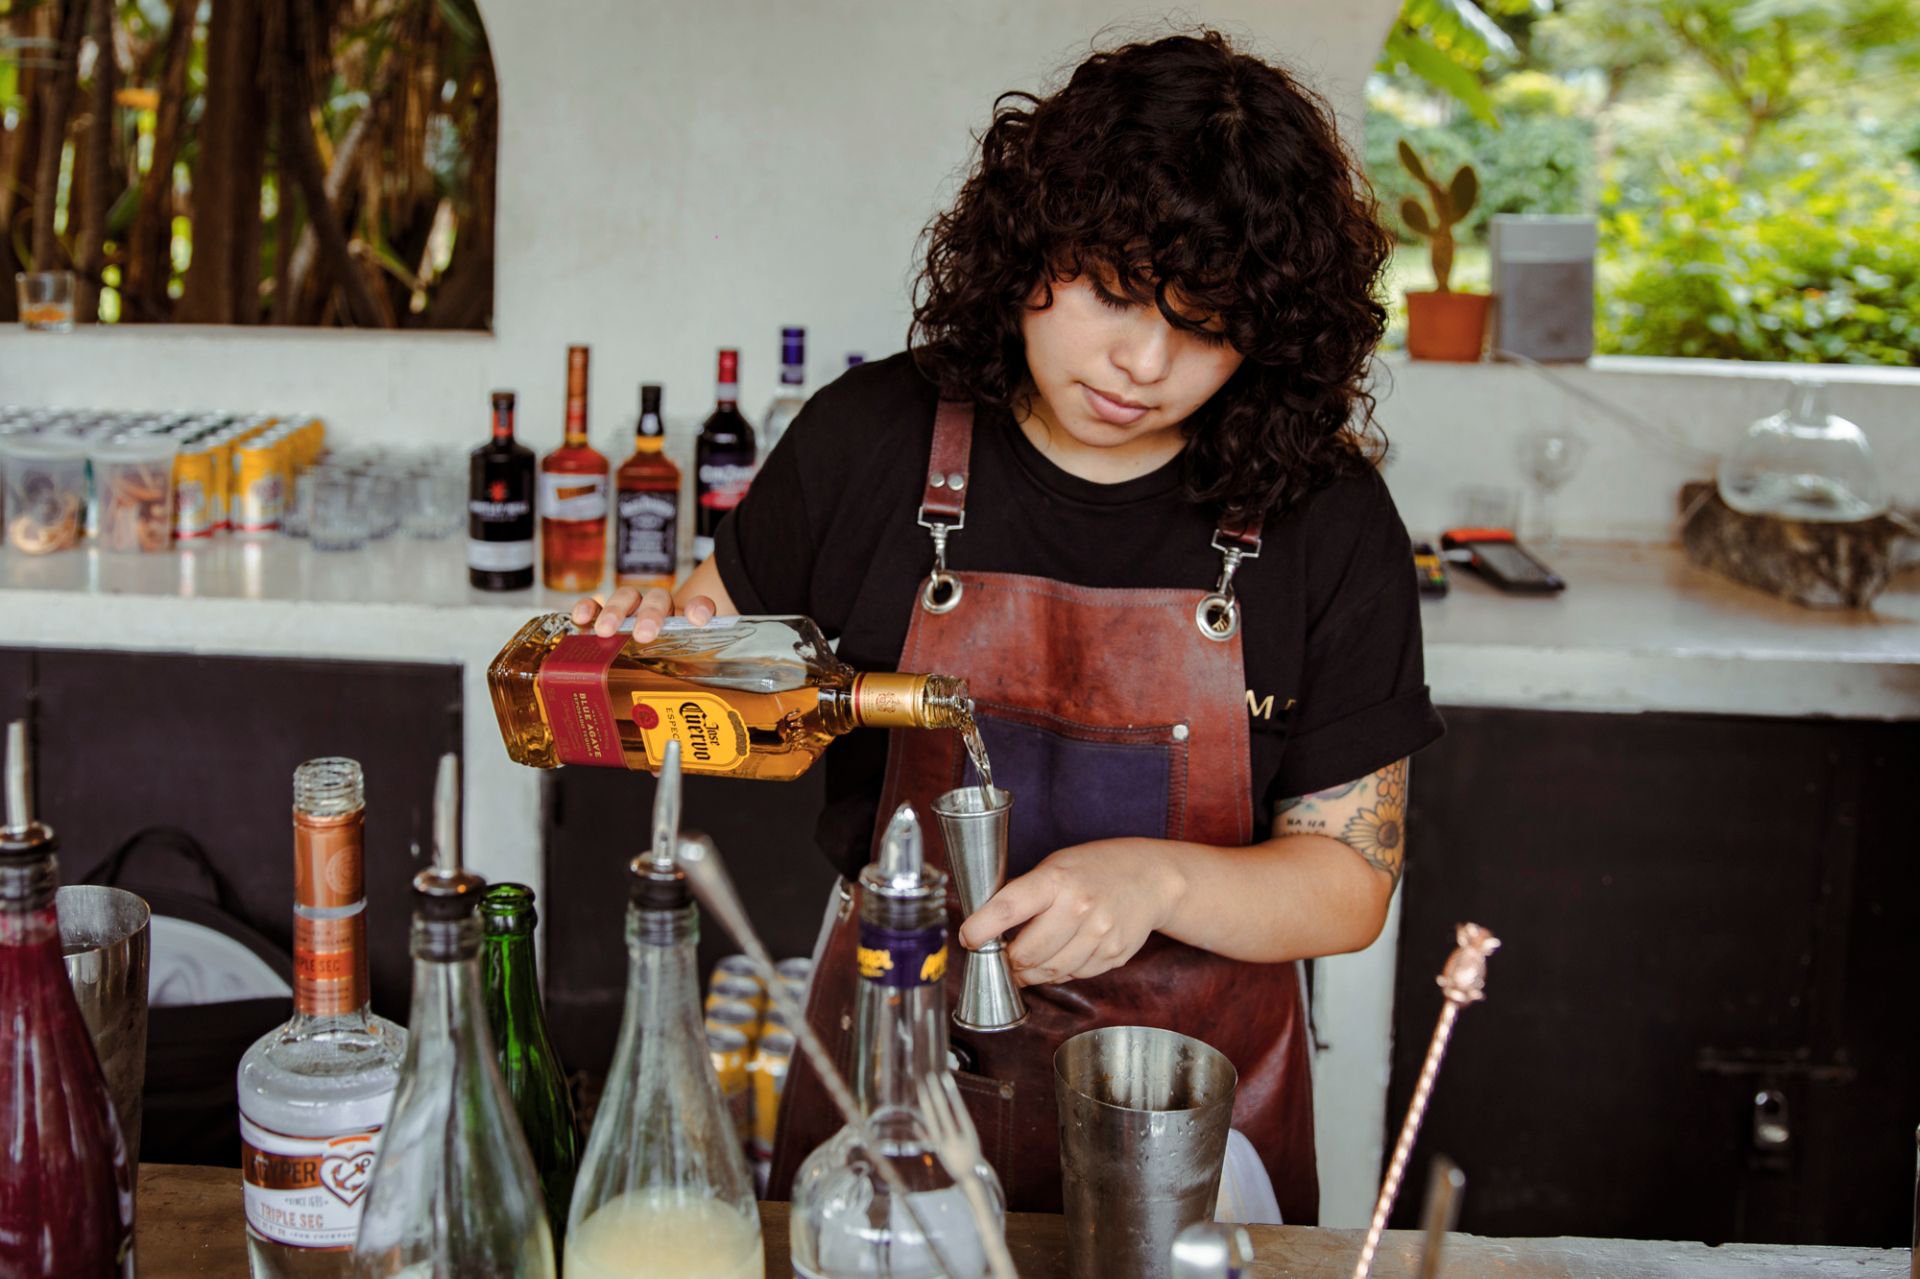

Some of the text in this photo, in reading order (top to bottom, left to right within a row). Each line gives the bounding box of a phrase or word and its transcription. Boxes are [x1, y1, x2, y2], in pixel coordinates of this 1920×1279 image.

[579, 693, 592, 721] BLUE
[587, 723, 602, 759] AGAVE
[666, 707, 683, 758] ESPEC
[679, 702, 711, 760] Cuervo
[705, 722, 720, 747] Jose
[260, 1202, 297, 1228] TRIPLE
[300, 1213, 324, 1229] SEC
